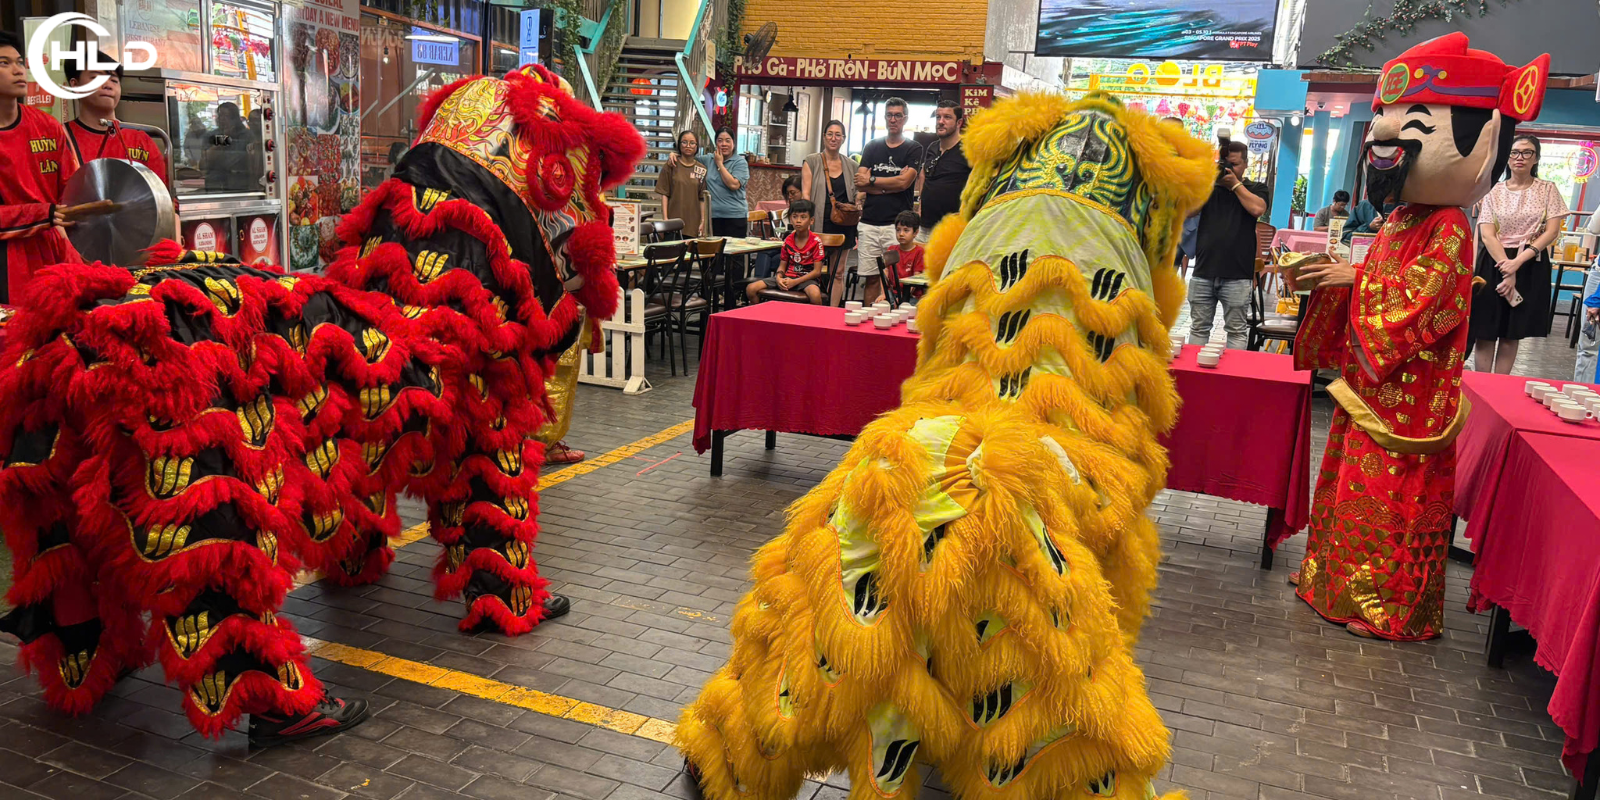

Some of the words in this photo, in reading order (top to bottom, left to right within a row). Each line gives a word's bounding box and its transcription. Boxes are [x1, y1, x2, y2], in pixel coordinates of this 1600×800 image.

[319, 10, 324, 24] A
[325, 12, 340, 28] NEW
[342, 16, 359, 32] MENU
[964, 107, 980, 116] PH
